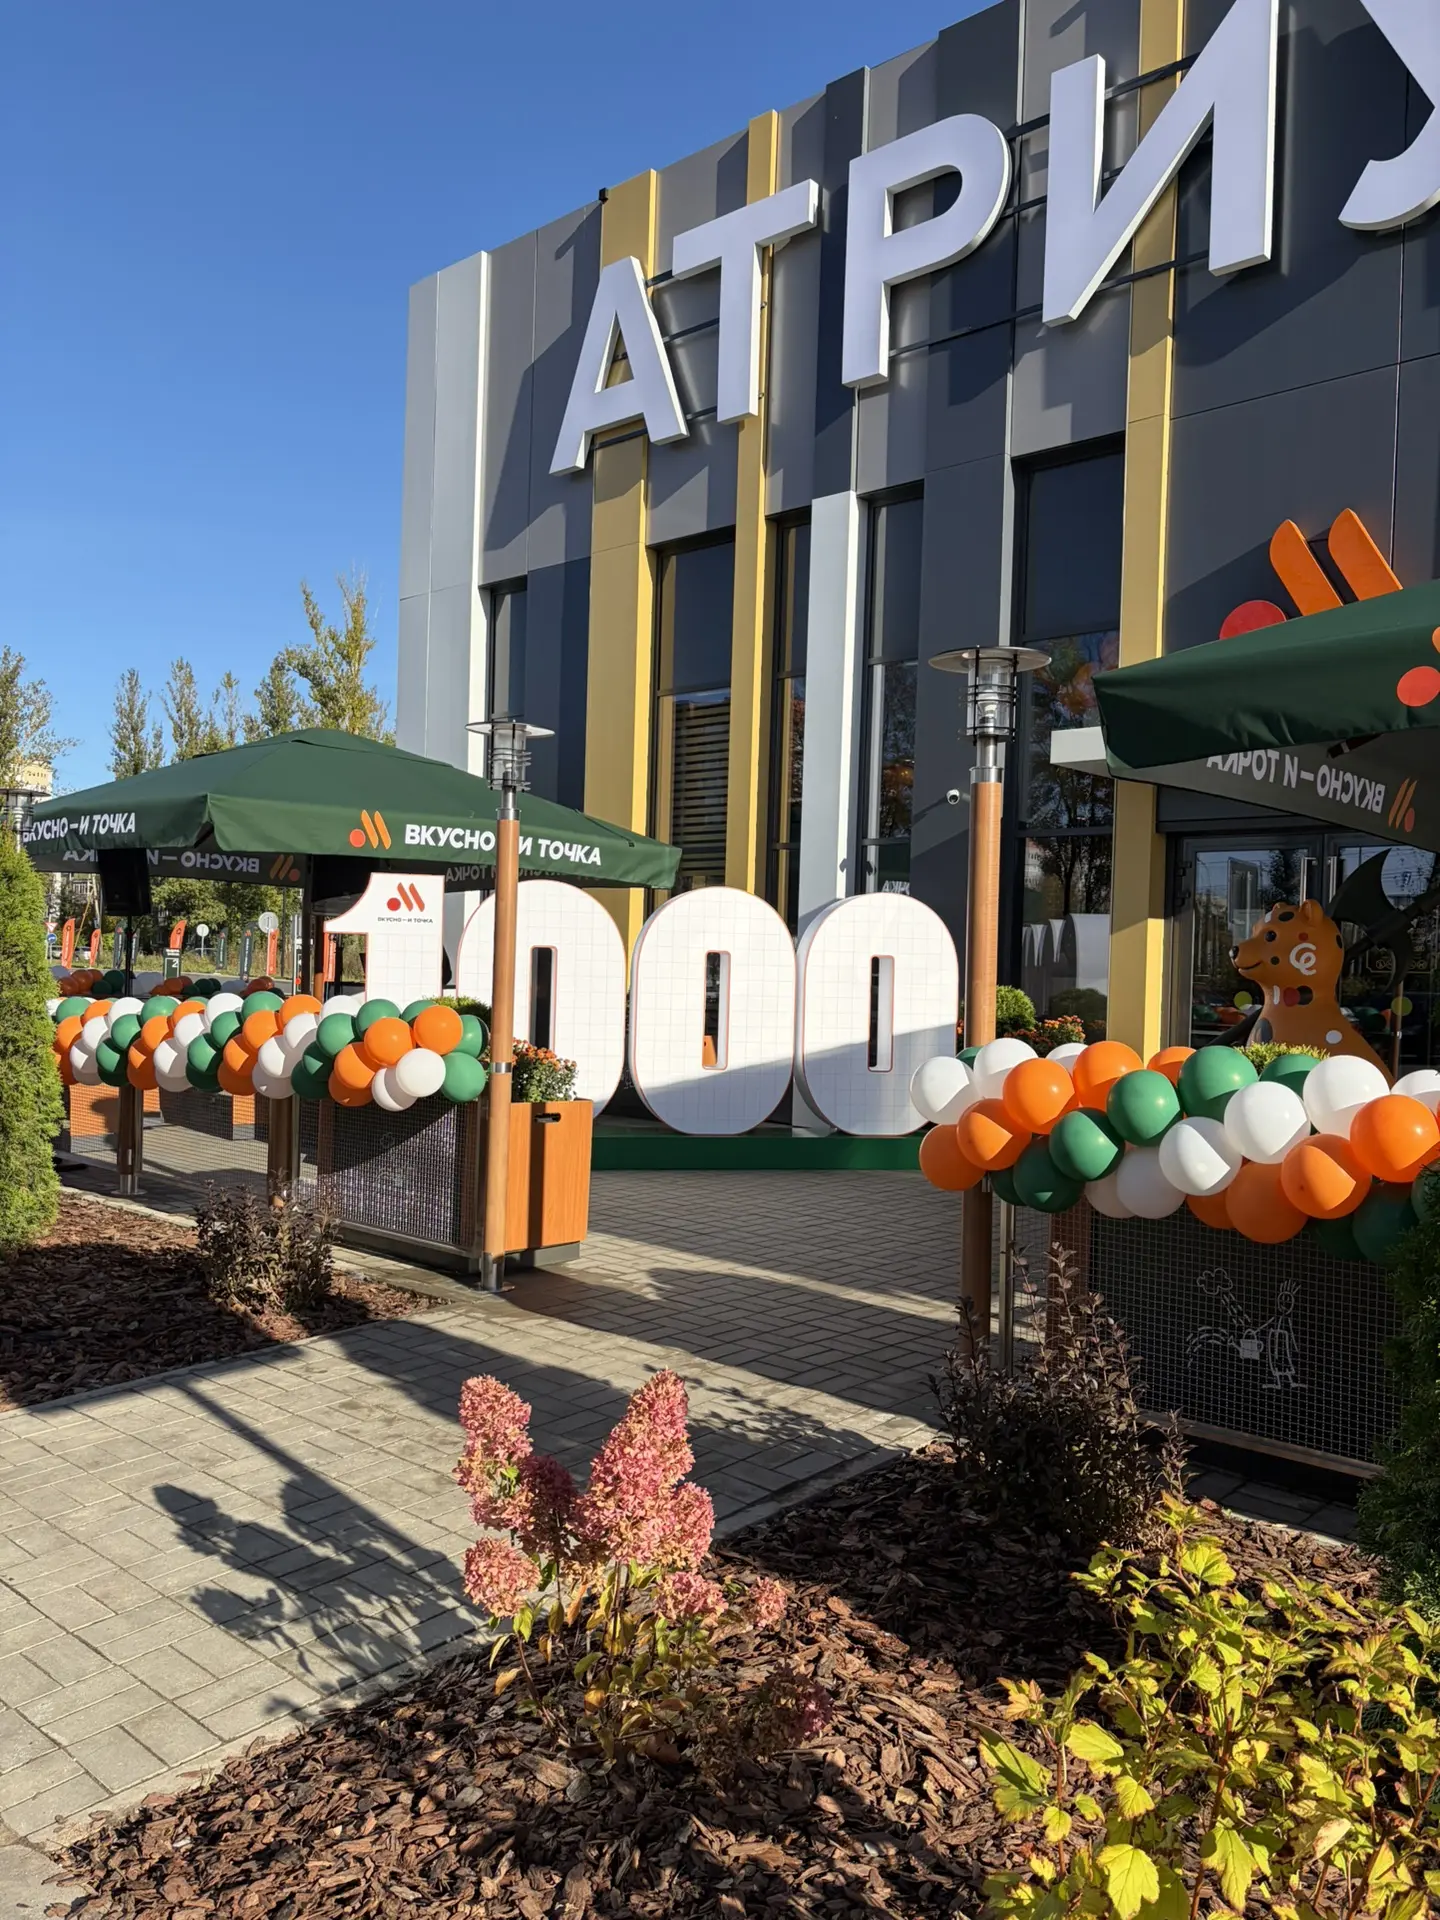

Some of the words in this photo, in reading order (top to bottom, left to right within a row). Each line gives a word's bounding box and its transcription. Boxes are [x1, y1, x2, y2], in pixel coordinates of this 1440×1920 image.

[80, 815, 90, 835] И
[92, 812, 135, 835] ТОЧКА
[405, 824, 496, 851] ВКУСНО
[518, 837, 532, 856] И
[537, 839, 601, 865] ТОЧКА
